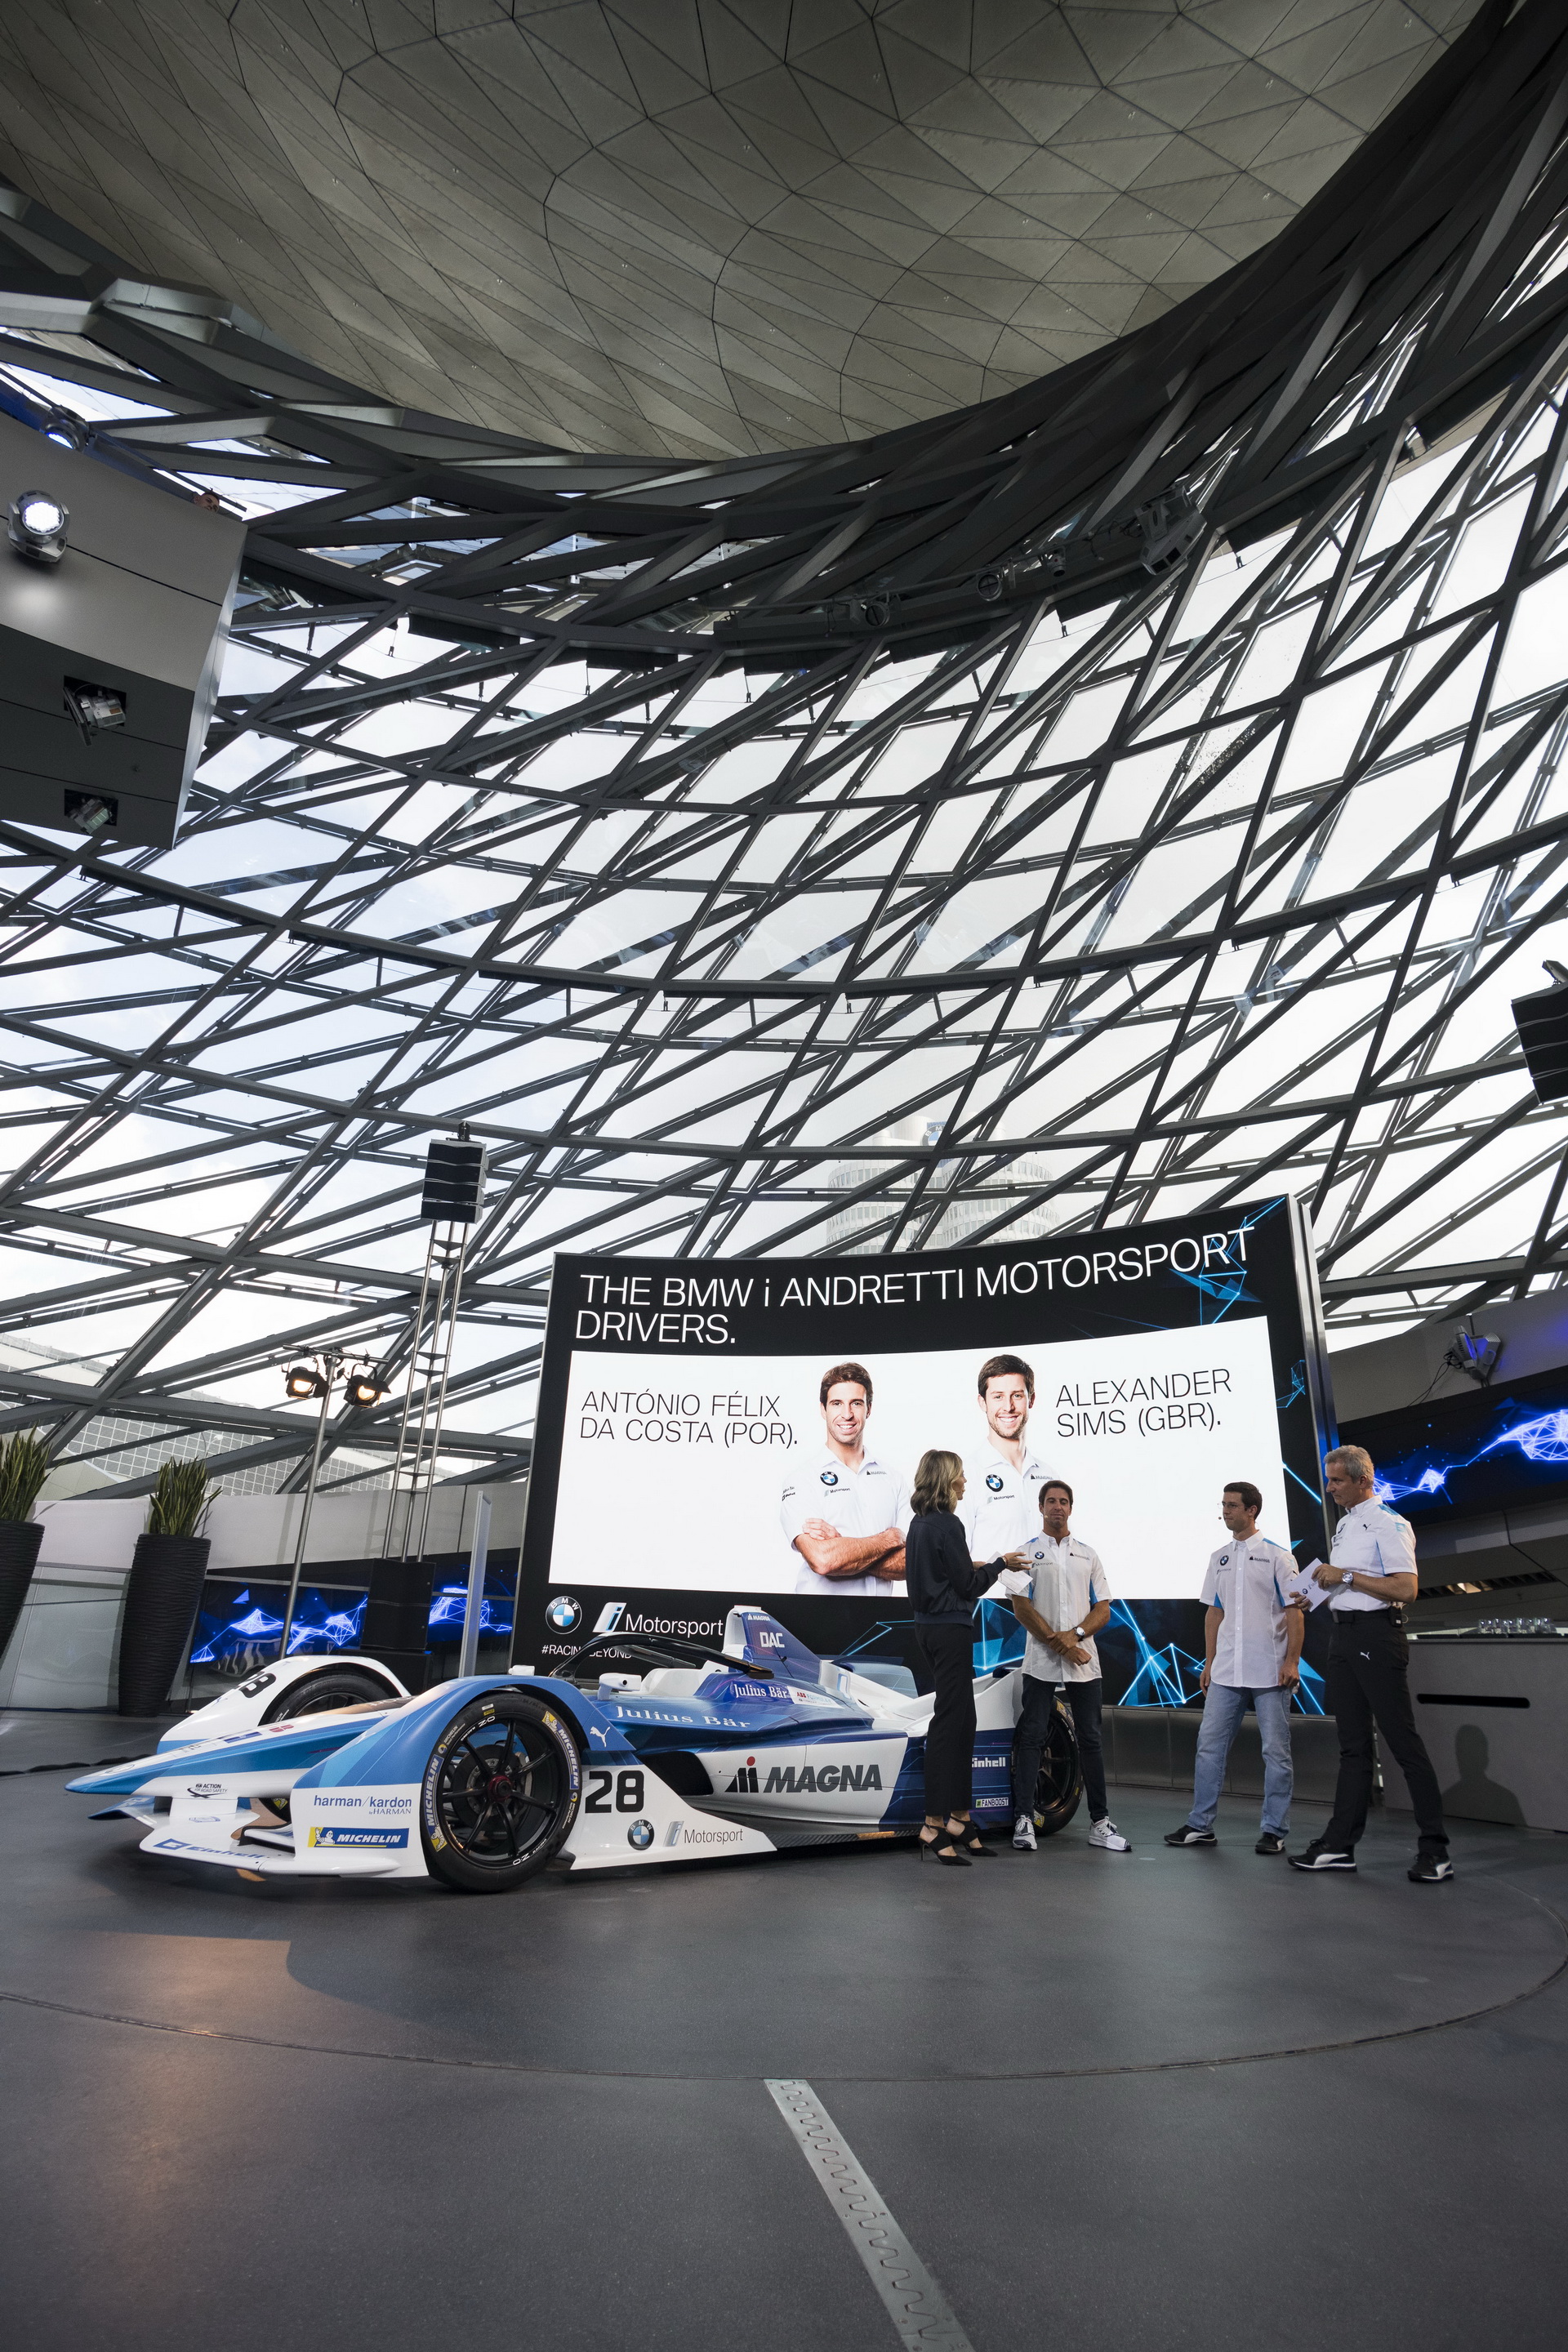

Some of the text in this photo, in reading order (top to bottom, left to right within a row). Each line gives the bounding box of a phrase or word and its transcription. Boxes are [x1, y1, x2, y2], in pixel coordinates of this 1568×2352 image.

[580, 1226, 1254, 1307] THE BMW i ANDRETTI MOTORSPORT
[575, 1310, 735, 1343] DRIVERS.
[581, 1388, 781, 1417] ANTÓNIO FÉLIX
[1056, 1368, 1232, 1408] ALEXANDER
[580, 1417, 798, 1449] DA COSTA (POR).
[1057, 1402, 1221, 1437] SIMS (GBR).
[625, 1613, 724, 1638] Motorsport
[760, 1632, 785, 1648] DAC
[733, 1684, 787, 1699] Julius Bär
[616, 1705, 751, 1728] Julius Bär
[559, 1728, 579, 1787] MICHELIN
[972, 1757, 1006, 1768] inhell
[425, 1757, 439, 1826] MICHELIN
[585, 1770, 645, 1814] 28
[763, 1764, 883, 1793] MAGNA
[336, 1834, 401, 1843] MICHELIN
[684, 1829, 743, 1845] Motorsport
[186, 1846, 267, 1859] Einhell
